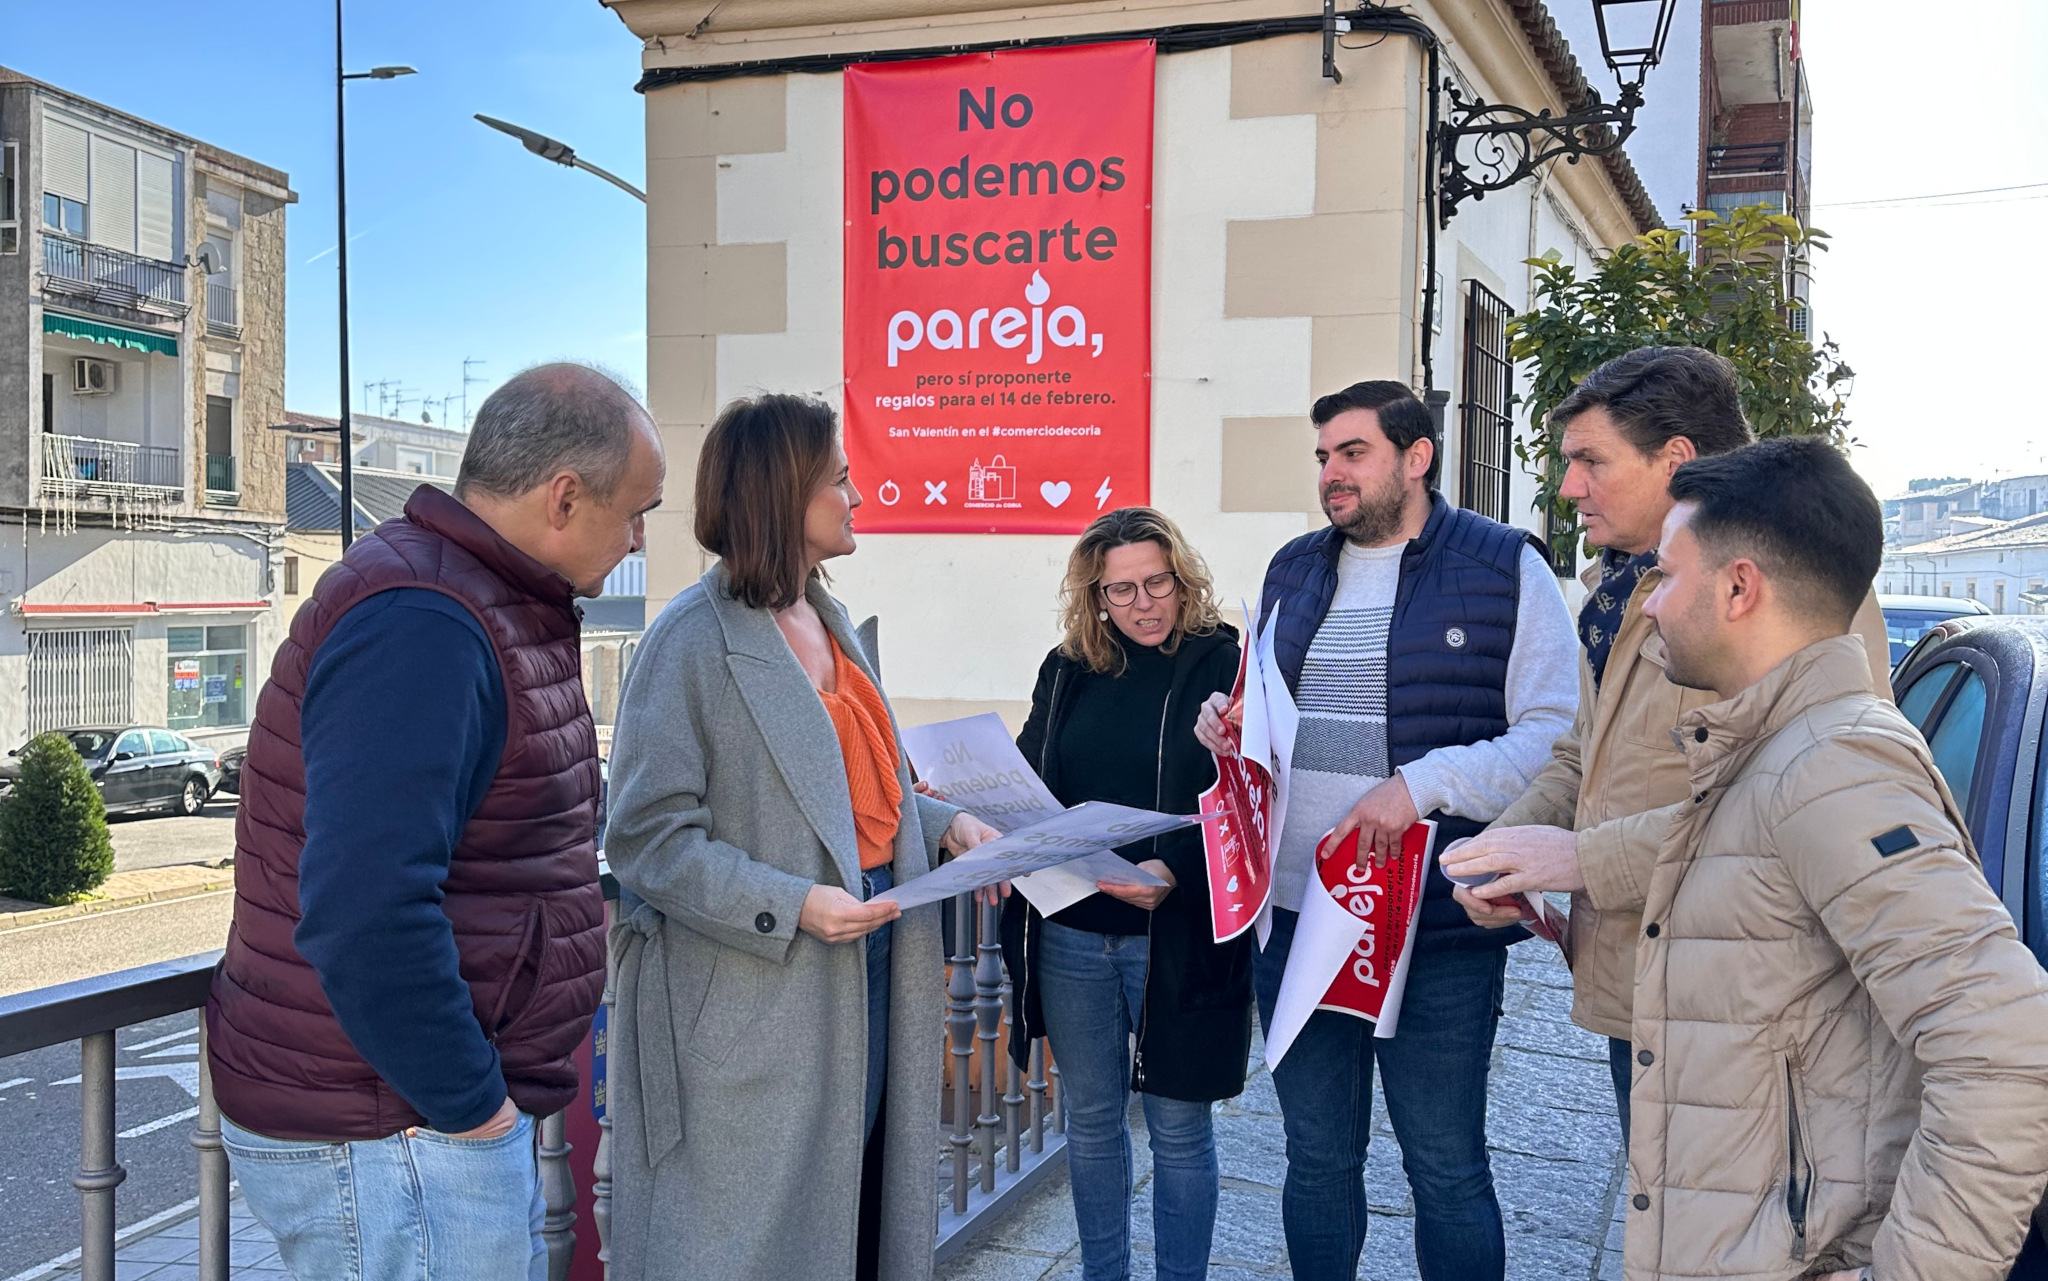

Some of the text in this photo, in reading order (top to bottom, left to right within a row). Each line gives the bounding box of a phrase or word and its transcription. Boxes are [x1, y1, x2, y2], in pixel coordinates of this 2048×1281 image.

[958, 86, 1034, 132] No
[871, 154, 1126, 215] podemos
[878, 219, 1118, 270] buscarte
[888, 269, 1104, 368] pareja,
[875, 389, 1117, 412] regalos para el 14 de febrero.
[916, 370, 1072, 390] pero sí proponerte
[888, 424, 1102, 438] San Valentín en el #comerciodecoria
